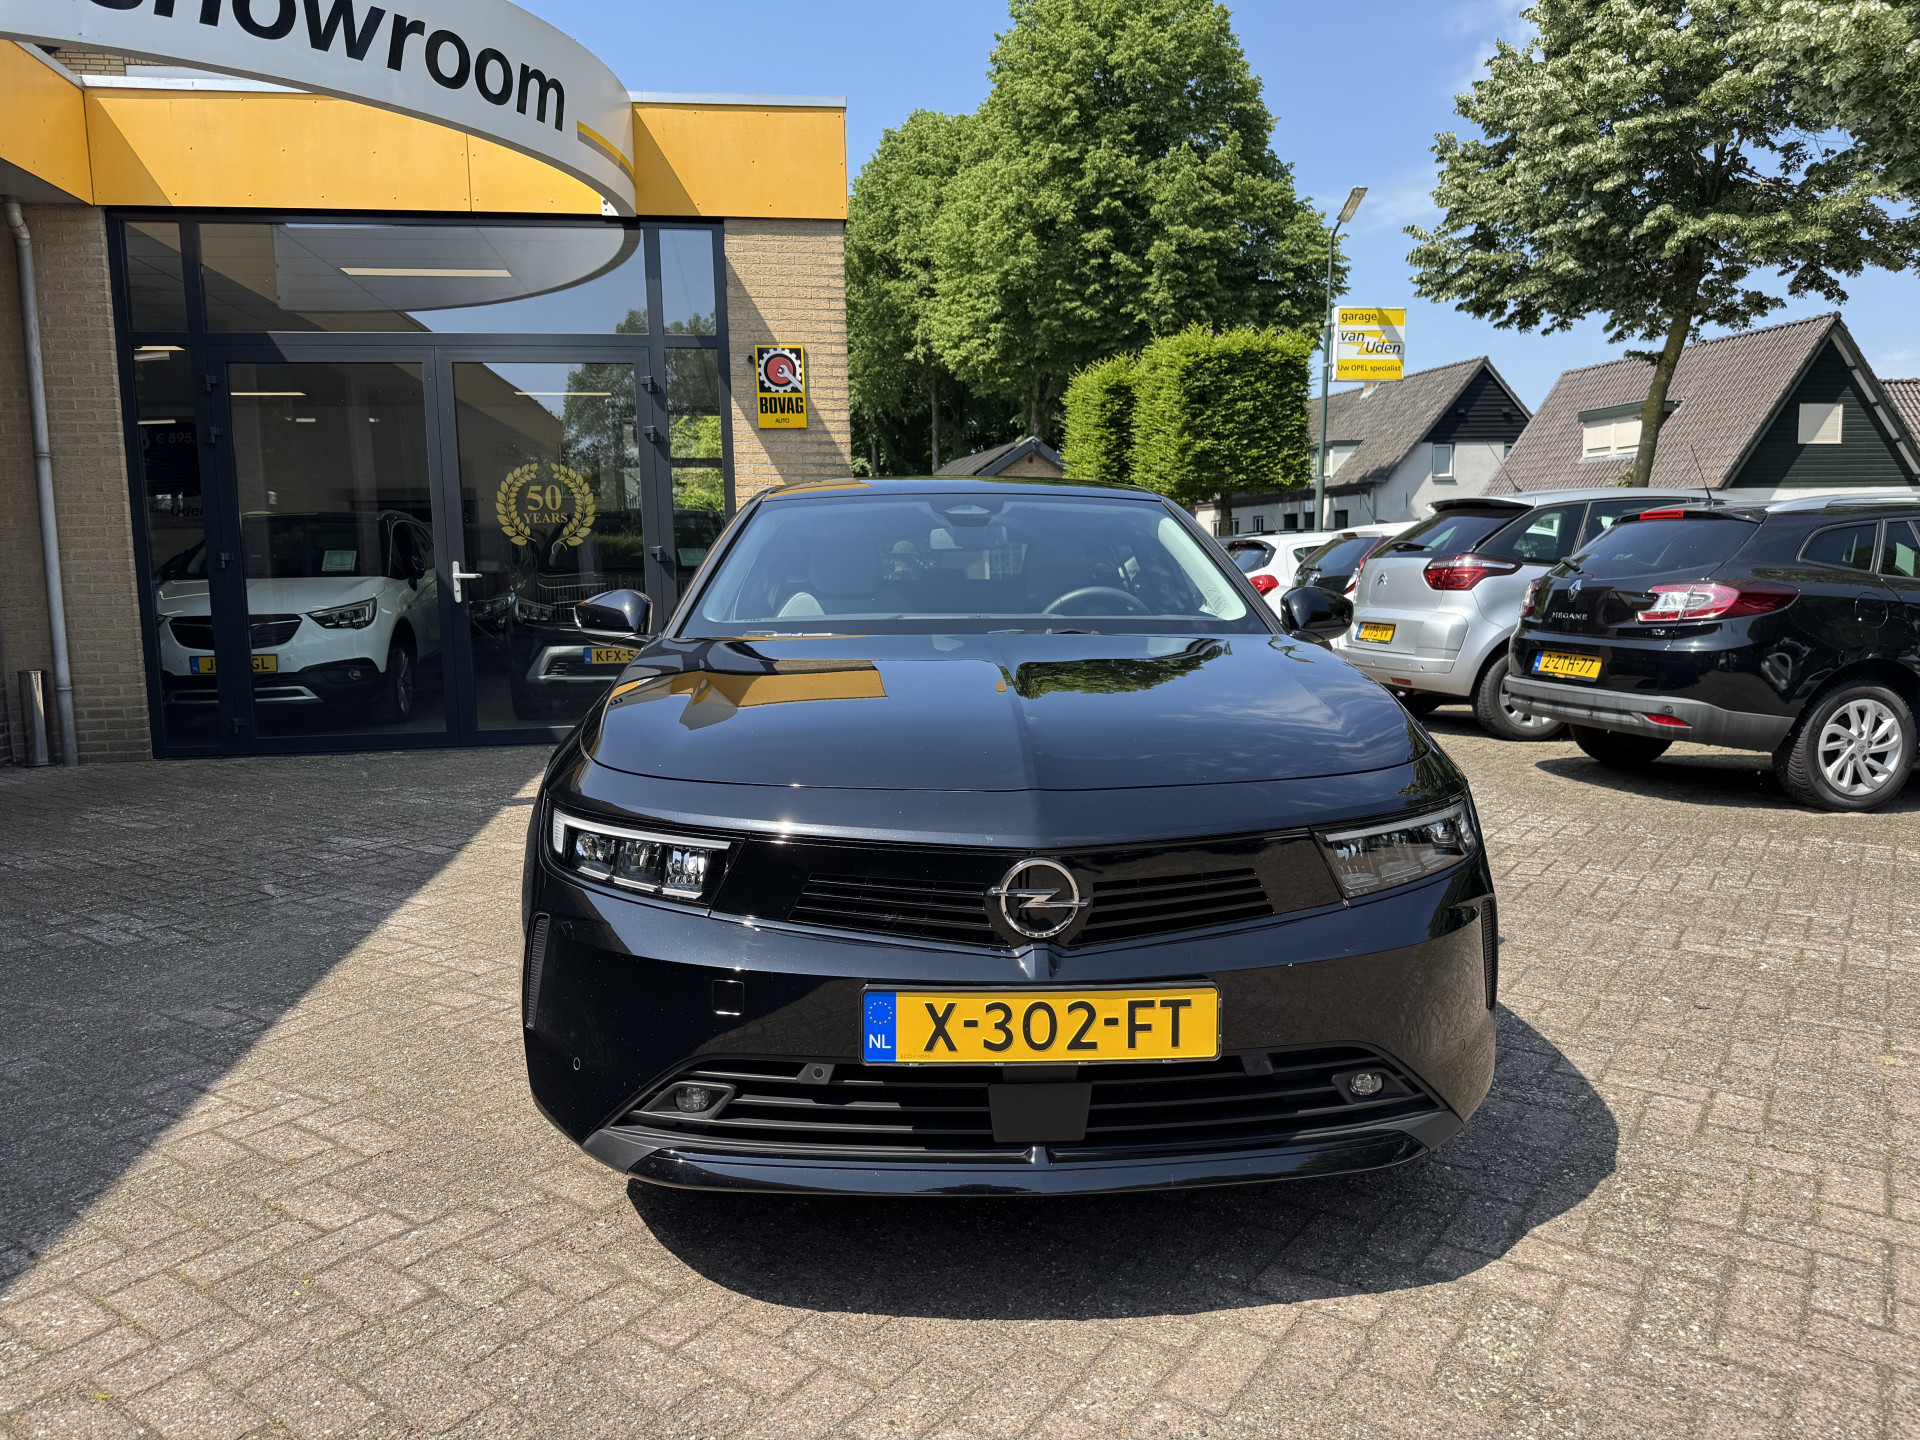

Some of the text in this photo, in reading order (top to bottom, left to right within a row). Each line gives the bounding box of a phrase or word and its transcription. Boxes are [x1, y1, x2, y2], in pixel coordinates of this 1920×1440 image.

[86, 0, 566, 132] owroom
[1341, 312, 1378, 323] garage
[1340, 331, 1401, 354] van Uden
[1369, 364, 1401, 374] specialist
[760, 397, 804, 414] BOVAG
[526, 484, 562, 511] 50
[170, 504, 204, 517] Ude
[523, 512, 569, 524] YEARS
[1543, 653, 1596, 674] 2-ZTH-77
[922, 998, 1192, 1053] X-302-FT
[868, 1033, 892, 1050] NL
